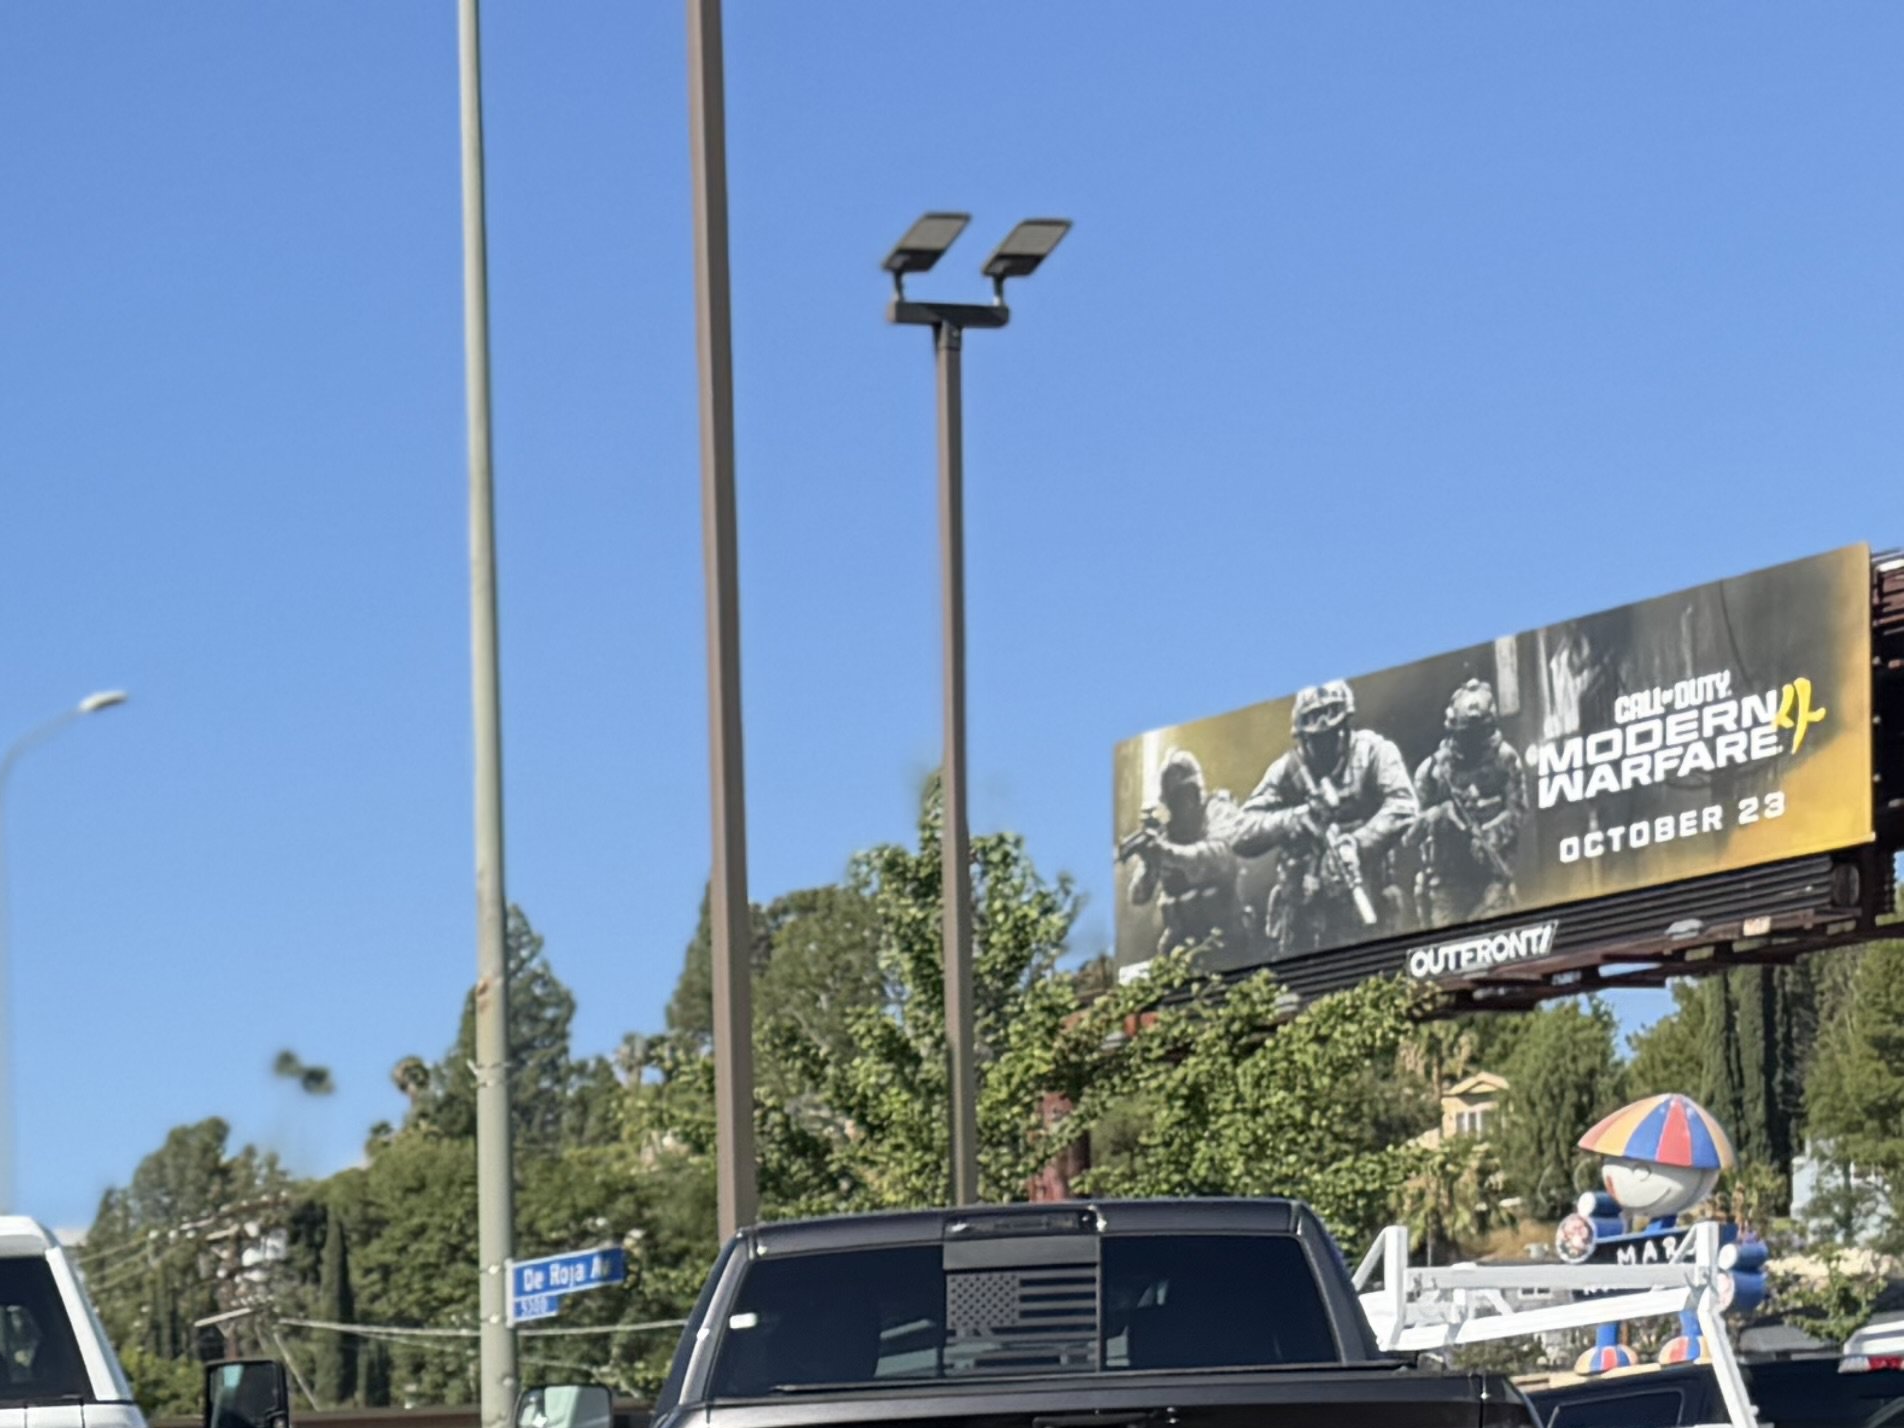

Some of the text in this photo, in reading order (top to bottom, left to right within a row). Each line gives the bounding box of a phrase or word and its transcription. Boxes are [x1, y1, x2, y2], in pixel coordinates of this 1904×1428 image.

[1614, 686, 1663, 724] CALL
[1674, 669, 1732, 710] DUTY
[1538, 689, 1778, 777] MODERN
[1538, 724, 1780, 808] WARFARE
[1558, 791, 1786, 863] OCTOBER 23
[523, 1268, 544, 1292] De
[549, 1263, 585, 1288] Roja
